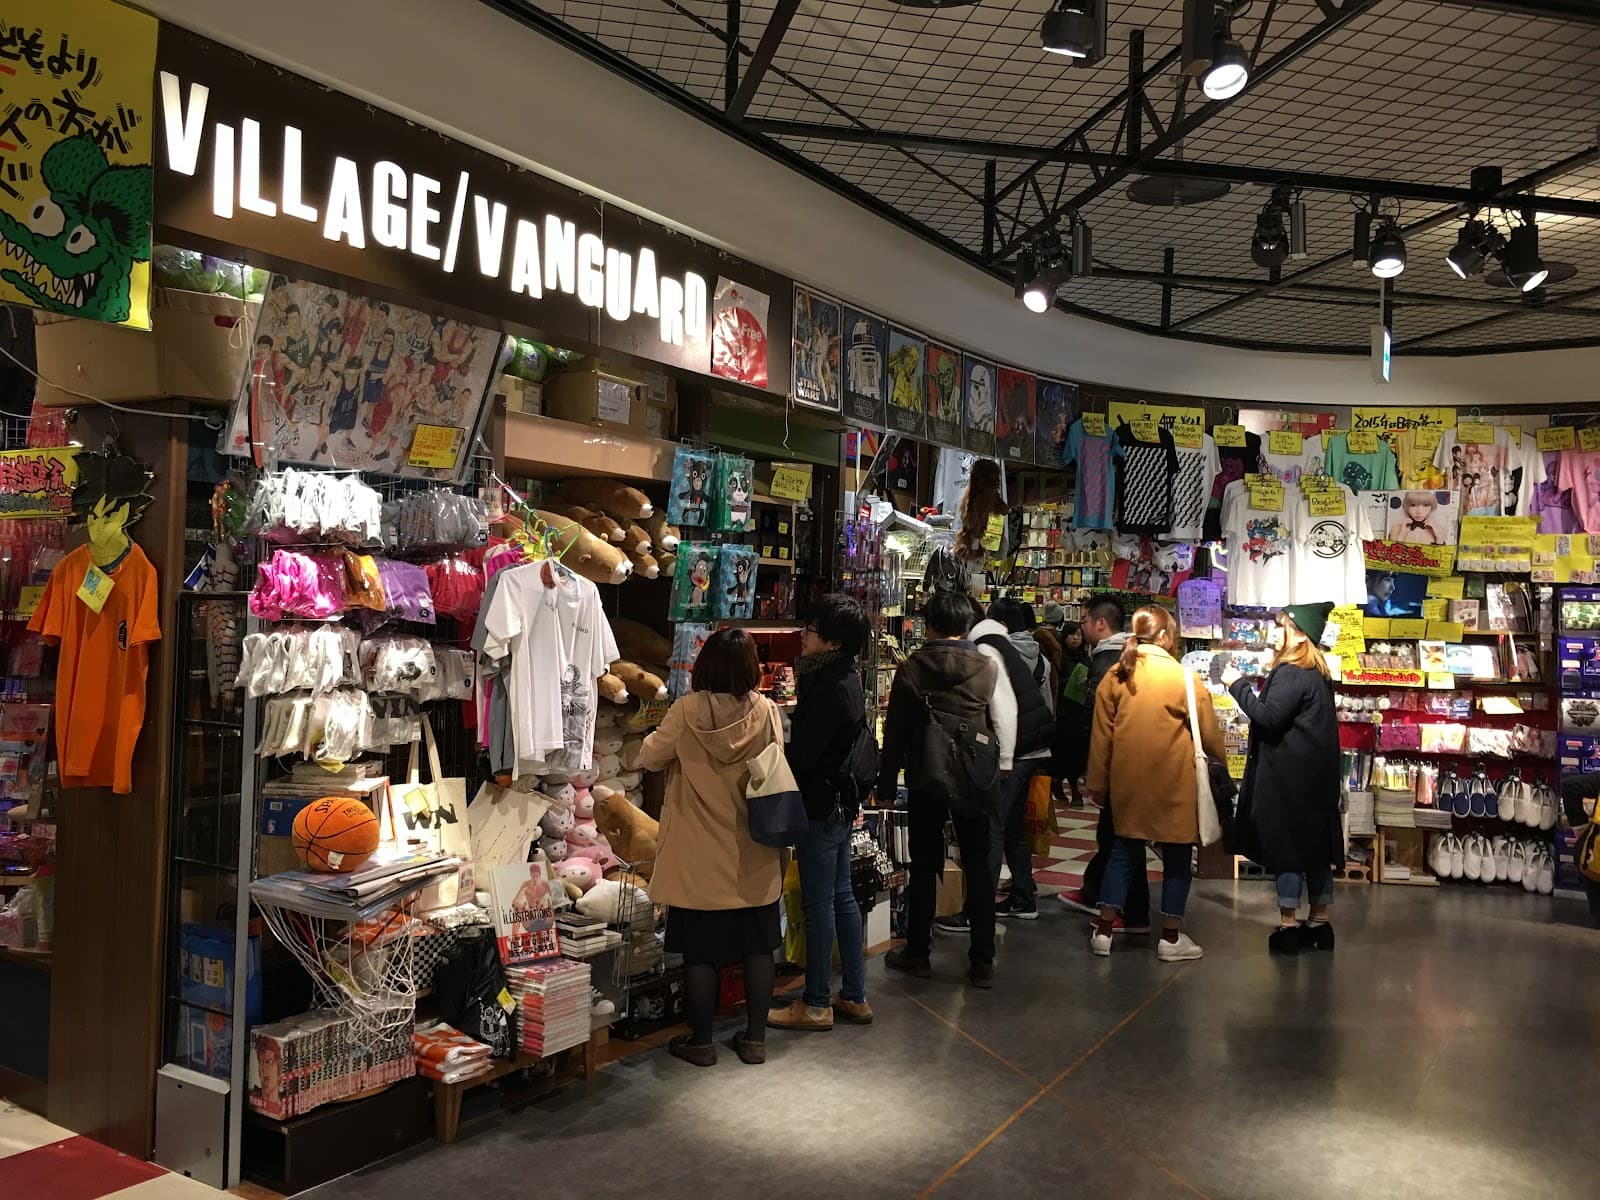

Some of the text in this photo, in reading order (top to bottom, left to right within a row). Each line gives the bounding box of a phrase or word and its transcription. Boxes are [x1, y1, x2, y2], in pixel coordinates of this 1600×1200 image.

[741, 322, 763, 342] Free
[797, 376, 820, 391] STAR
[797, 386, 820, 402] WARS
[502, 907, 553, 925] ILLUSTRATIONS
